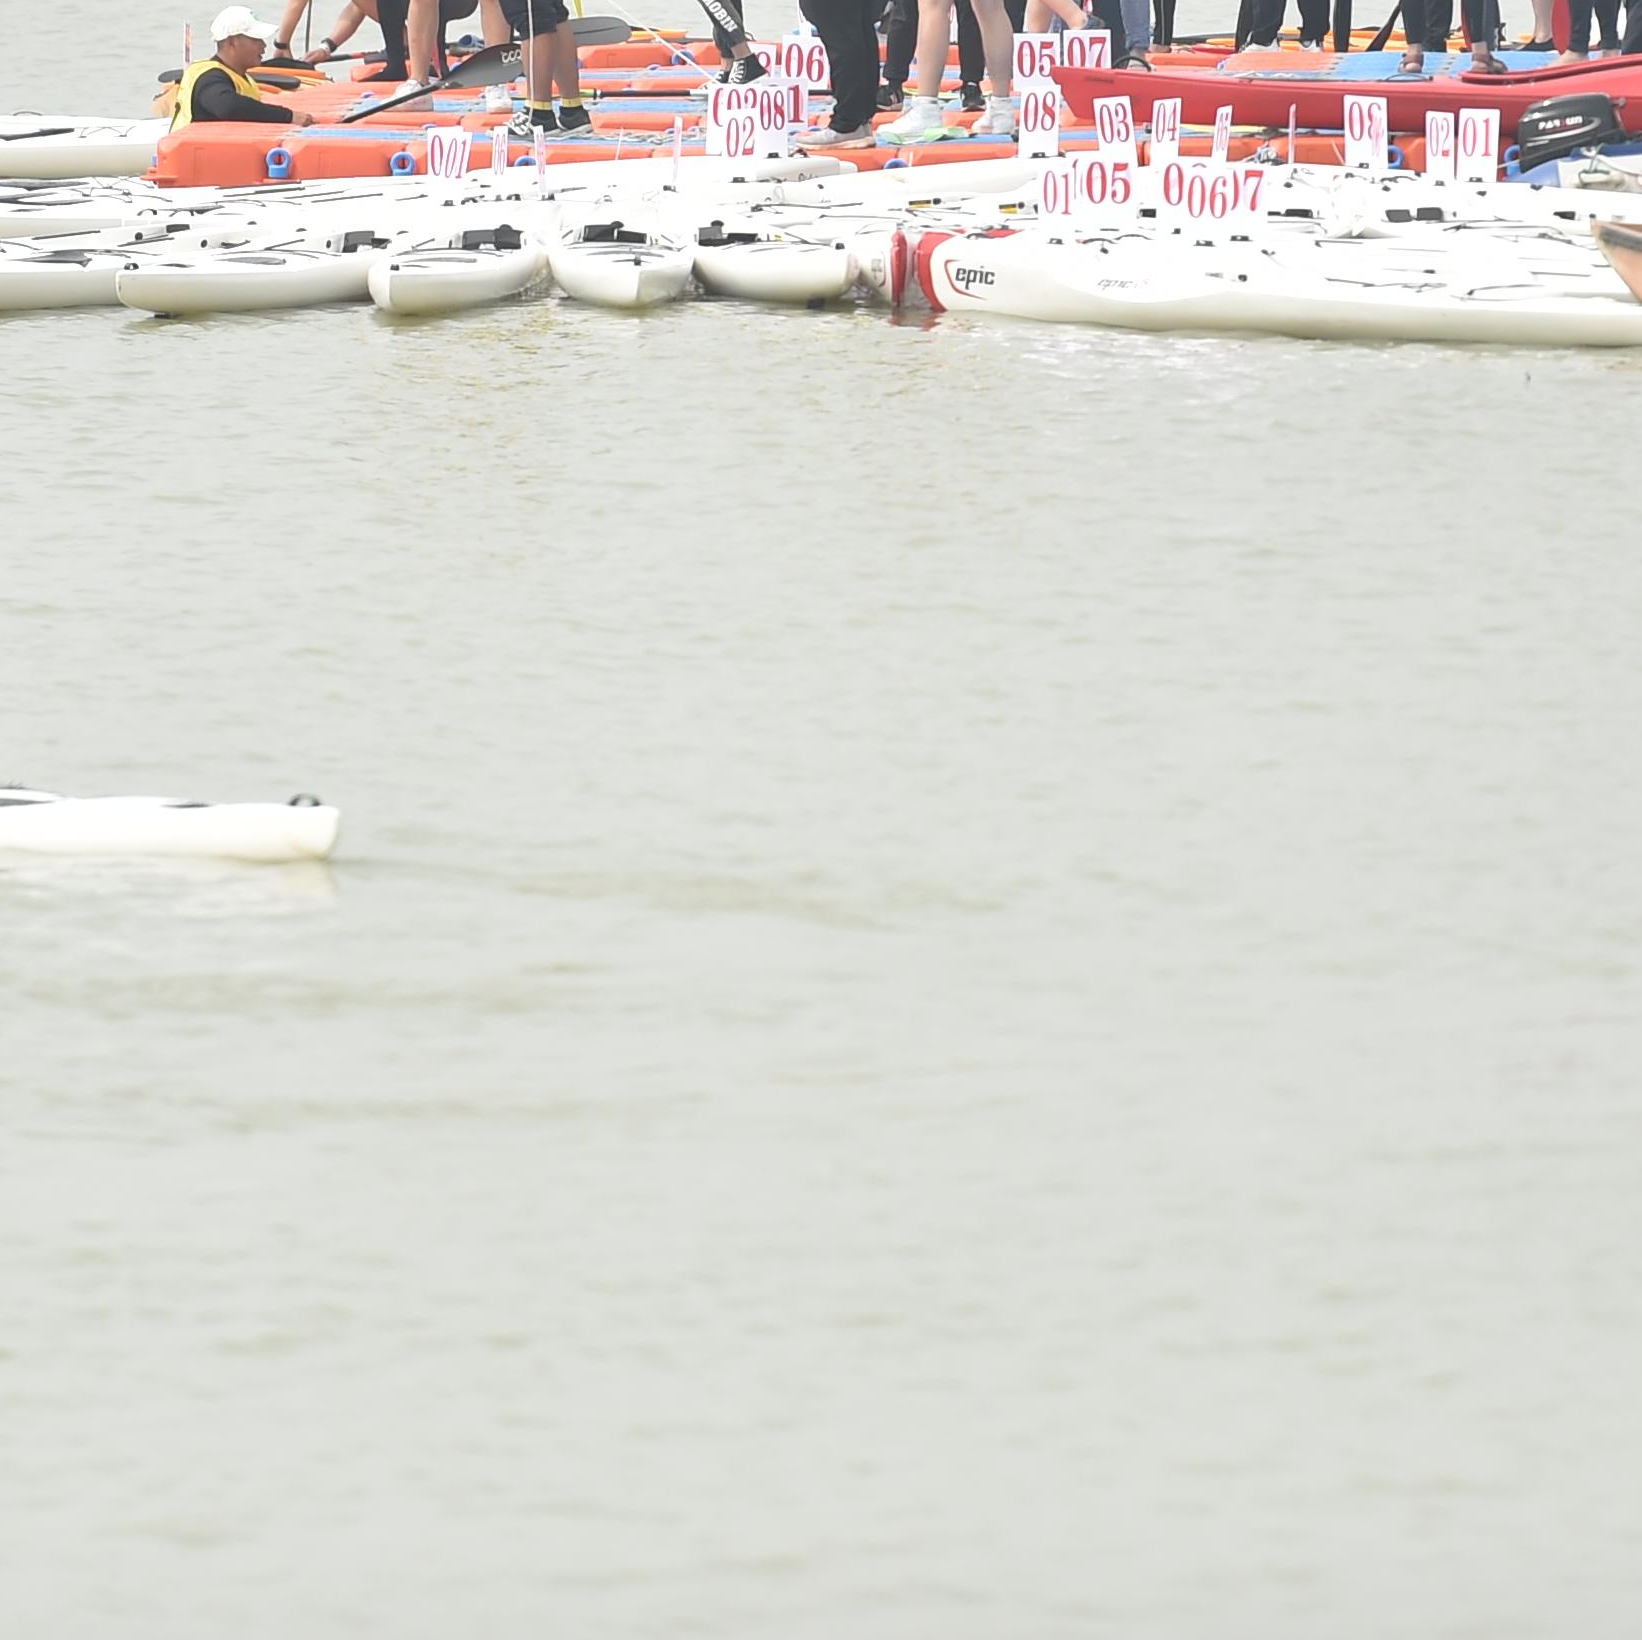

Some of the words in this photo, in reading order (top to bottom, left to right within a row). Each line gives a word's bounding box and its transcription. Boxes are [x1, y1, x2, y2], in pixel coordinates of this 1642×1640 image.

[785, 43, 824, 83] 06
[1017, 40, 1056, 78] 05
[1067, 36, 1107, 68] 07
[759, 90, 785, 131] 08
[1023, 91, 1057, 133] 08
[1099, 102, 1131, 144] 03
[1155, 101, 1178, 144] 04
[726, 115, 755, 158] 02
[1429, 116, 1451, 158] 02
[1462, 116, 1491, 158] 01
[1043, 170, 1072, 216] 01
[1086, 161, 1131, 205] 05
[1187, 175, 1228, 219] 06
[955, 265, 996, 290] epic
